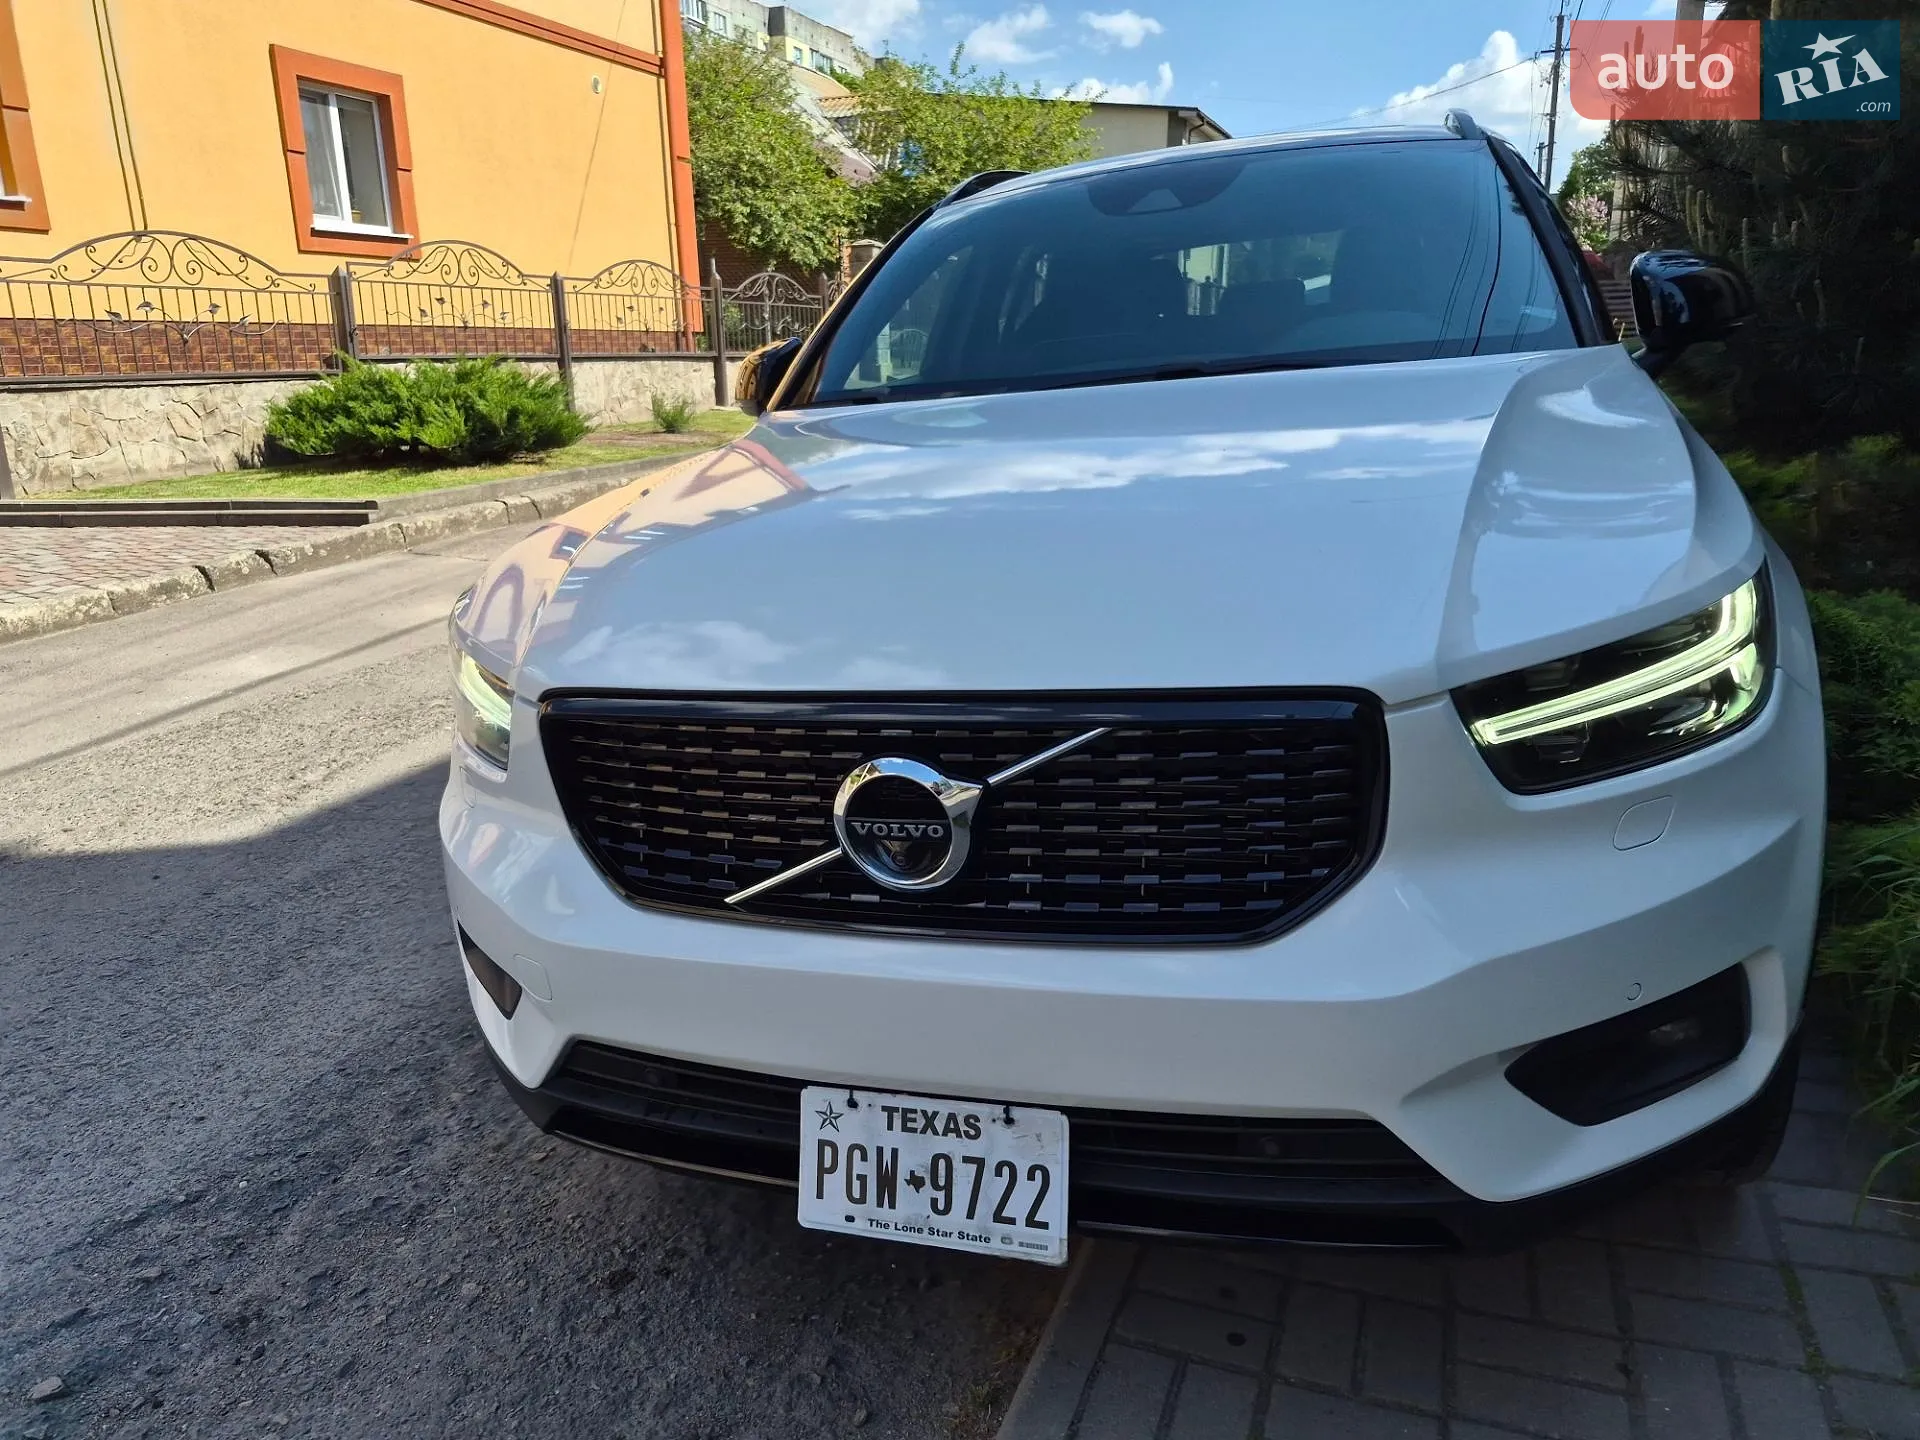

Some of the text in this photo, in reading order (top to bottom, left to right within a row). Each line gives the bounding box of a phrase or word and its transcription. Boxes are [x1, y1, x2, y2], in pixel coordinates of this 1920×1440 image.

[851, 822, 944, 838] VOLVO
[881, 1105, 982, 1141] TEXAS
[867, 1218, 891, 1230] The
[894, 1221, 924, 1235] Lone
[927, 1225, 953, 1239] Star
[957, 1230, 992, 1244] State
